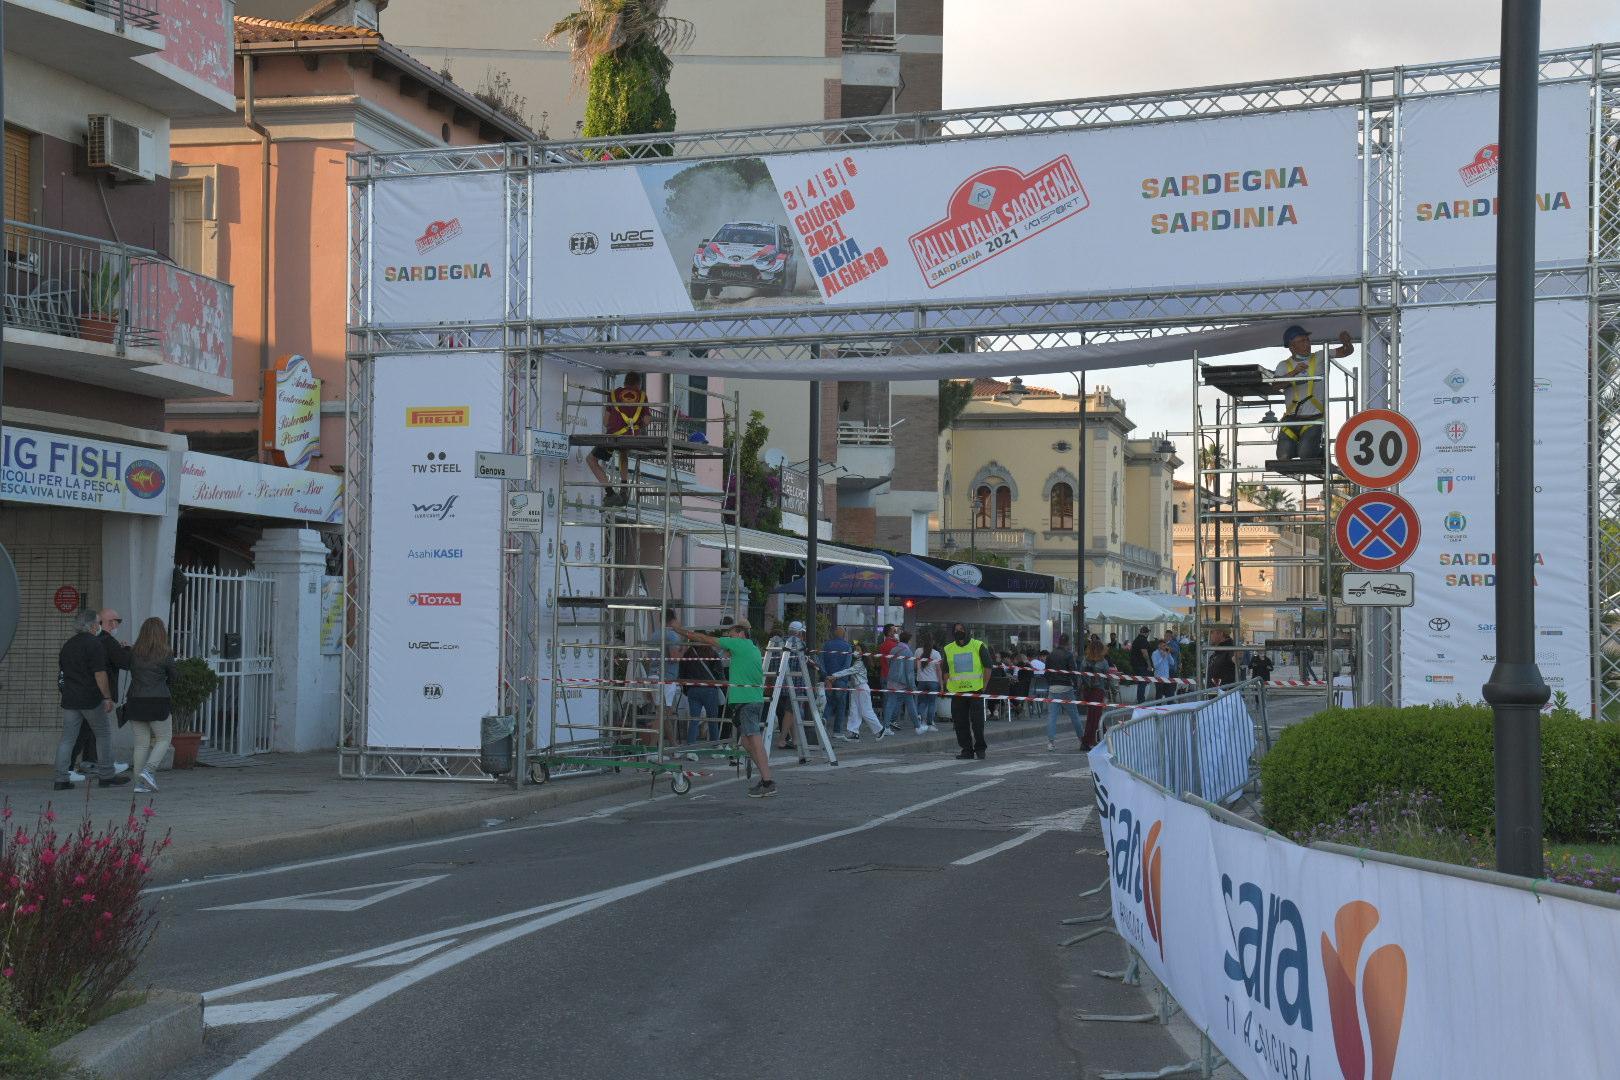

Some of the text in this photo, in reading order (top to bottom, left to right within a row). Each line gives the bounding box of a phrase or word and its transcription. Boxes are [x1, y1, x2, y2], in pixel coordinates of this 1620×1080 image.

[1141, 166, 1309, 199] SARDEGNA
[794, 189, 856, 236] GIUGNO
[912, 161, 1080, 271] RALLY ITALIA SARDEGNA
[1151, 204, 1298, 235] SARDINIA
[1416, 192, 1572, 222] SARDNA
[804, 219, 847, 257] 2021
[931, 228, 1020, 281] SARDEGNA 2021
[384, 263, 492, 282] SARDEGNA
[812, 237, 863, 278] OLBIA
[821, 246, 889, 298] ALGHERO
[411, 410, 464, 424] PIRELLI
[2, 434, 122, 480] IG FISH
[1353, 430, 1403, 466] 30
[38, 473, 63, 487] PER
[65, 476, 82, 489] LA
[83, 480, 121, 493] PESCA
[412, 463, 462, 473] TW STEEL
[480, 465, 506, 476] Genova
[29, 485, 54, 498] VIVA
[56, 488, 79, 500] LIVE
[81, 491, 104, 503] BAIT
[1440, 553, 1545, 566] SARDA
[1221, 873, 1314, 1032] sara
[1225, 994, 1237, 1036] TI
